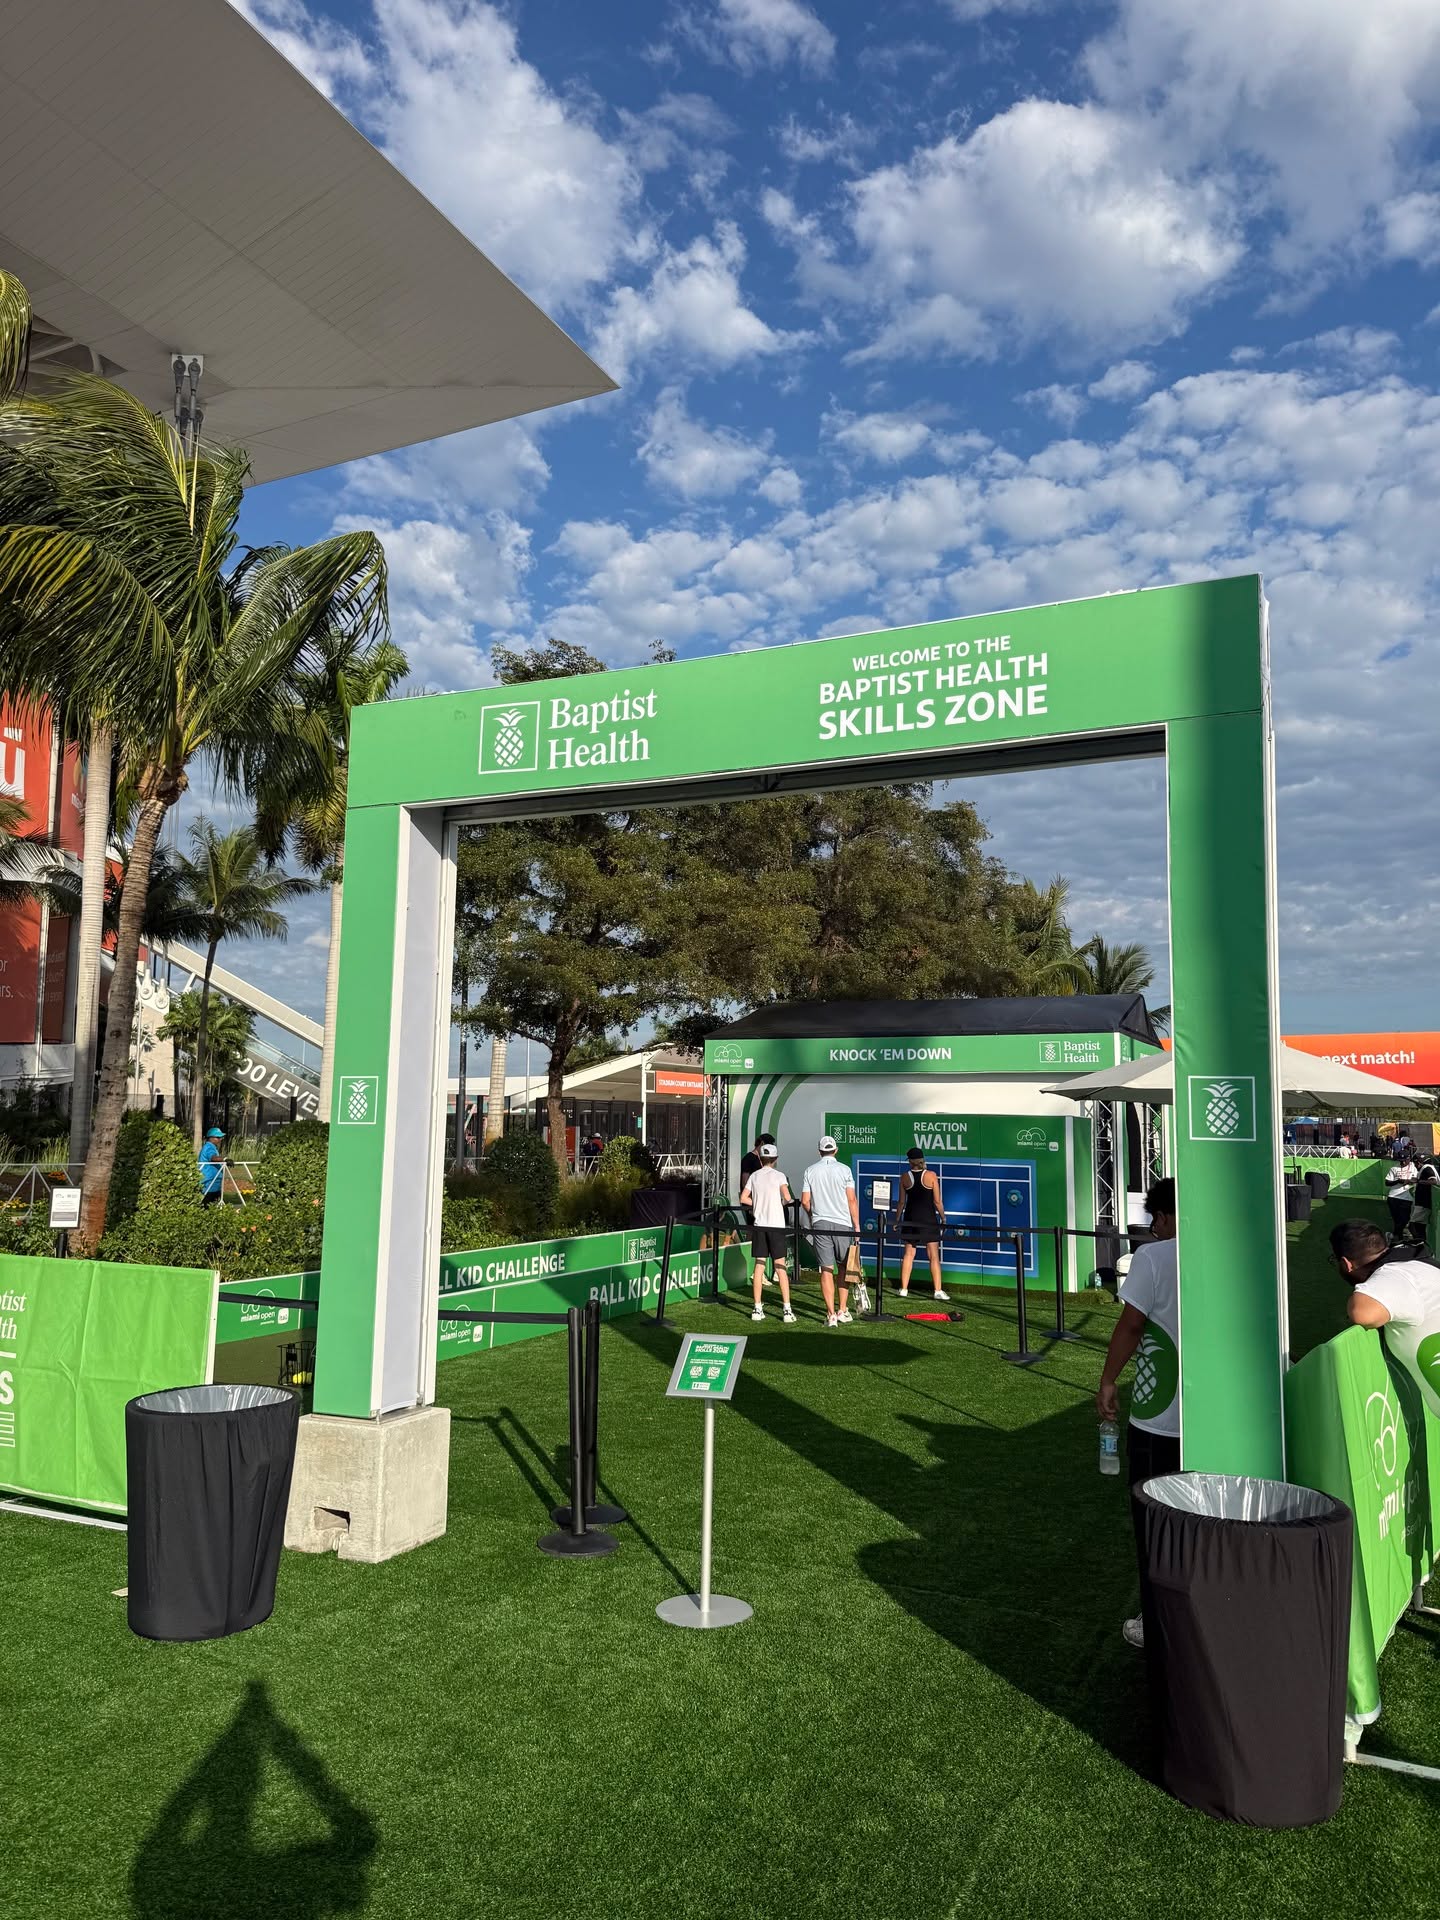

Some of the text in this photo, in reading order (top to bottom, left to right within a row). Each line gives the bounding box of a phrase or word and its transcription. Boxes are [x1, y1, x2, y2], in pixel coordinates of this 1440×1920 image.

[852, 635, 1011, 672] WELCOME TO THE
[819, 652, 1048, 705] BAPTIST HEALTH
[548, 688, 658, 734] Baptist
[819, 683, 1048, 740] SKILLS ZONE
[547, 728, 651, 770] Health
[0, 985, 14, 999] rs.
[1063, 1040, 1101, 1053] Baptist
[829, 1048, 878, 1061] KNOCK
[907, 1047, 952, 1060] DOWN
[1063, 1052, 1100, 1063] Health
[1321, 1050, 1415, 1065] next match!
[264, 1072, 320, 1117] LEVE
[848, 1125, 877, 1137] Baptist
[913, 1121, 967, 1132] REACTION
[848, 1135, 876, 1144] Health
[914, 1133, 968, 1151] WALL
[639, 1236, 657, 1247] Baptist
[456, 1266, 483, 1288] KID
[486, 1253, 566, 1283] CHALLENGE
[628, 1274, 651, 1300] KID
[652, 1261, 720, 1294] CALLENG
[240, 1312, 260, 1323] miami
[260, 1311, 276, 1321] open
[440, 1328, 471, 1341] miami open
